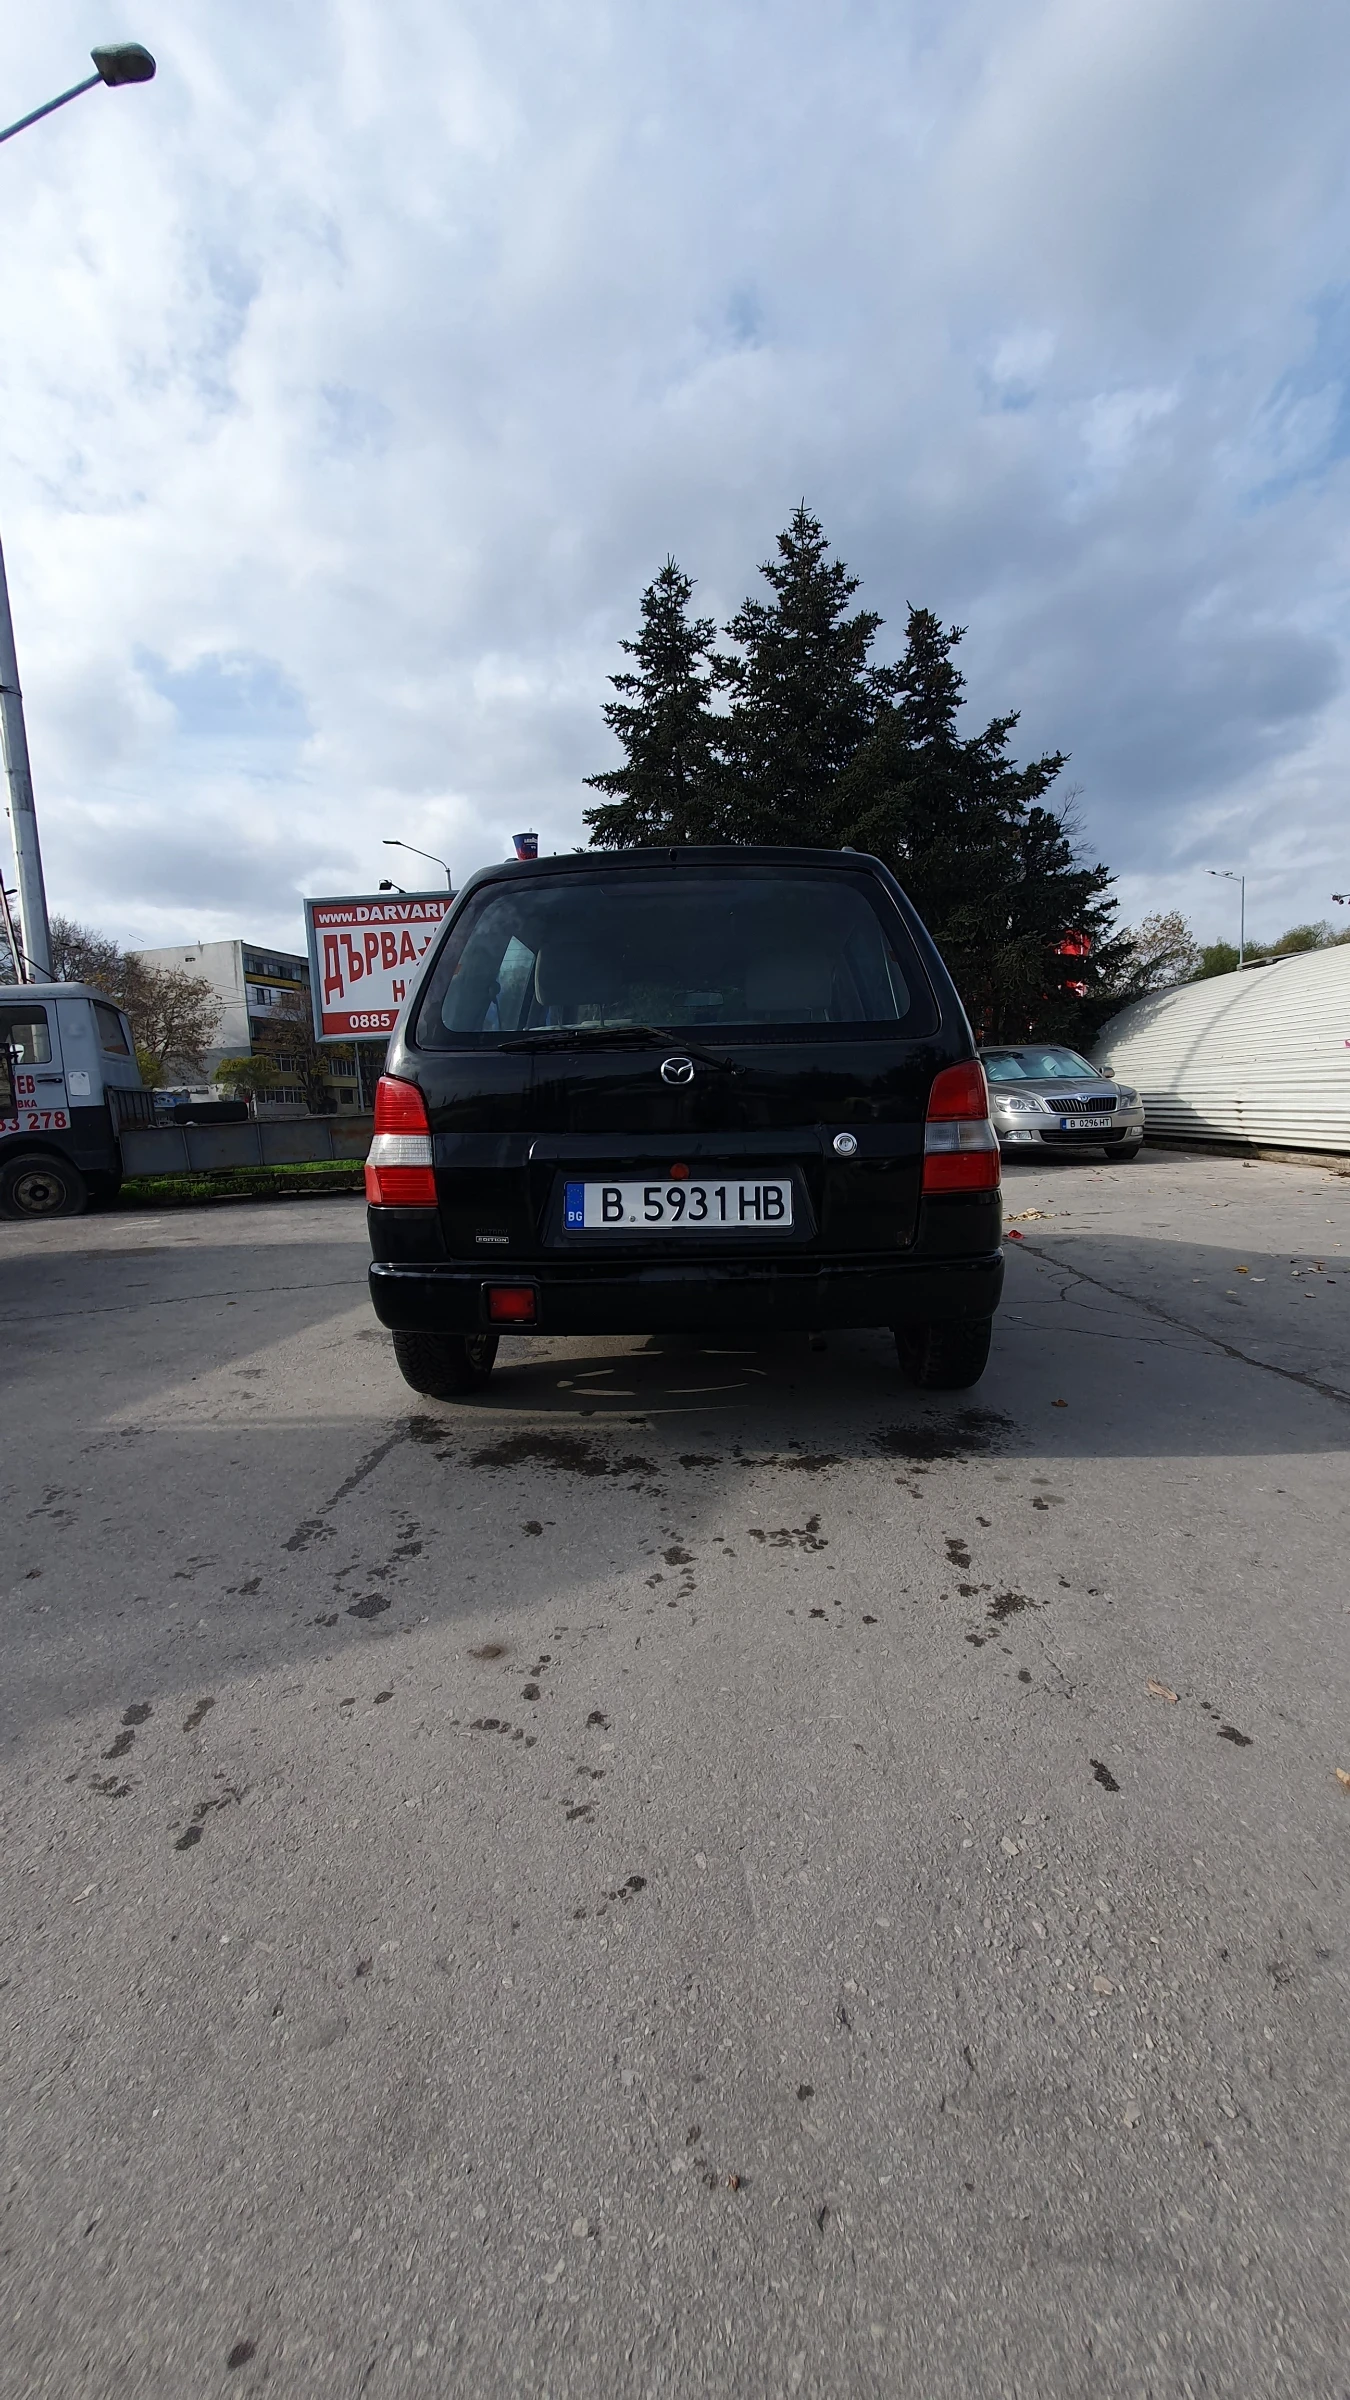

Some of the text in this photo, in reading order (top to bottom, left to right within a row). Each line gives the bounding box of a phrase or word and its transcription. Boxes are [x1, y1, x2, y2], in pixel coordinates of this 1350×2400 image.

[323, 931, 417, 1005] ДЪРВА
[349, 1013, 390, 1028] 0885
[13, 1075, 36, 1094] ЕВ
[17, 1100, 37, 1108] ВКА
[27, 1111, 67, 1130] 278
[567, 1211, 583, 1222] BG
